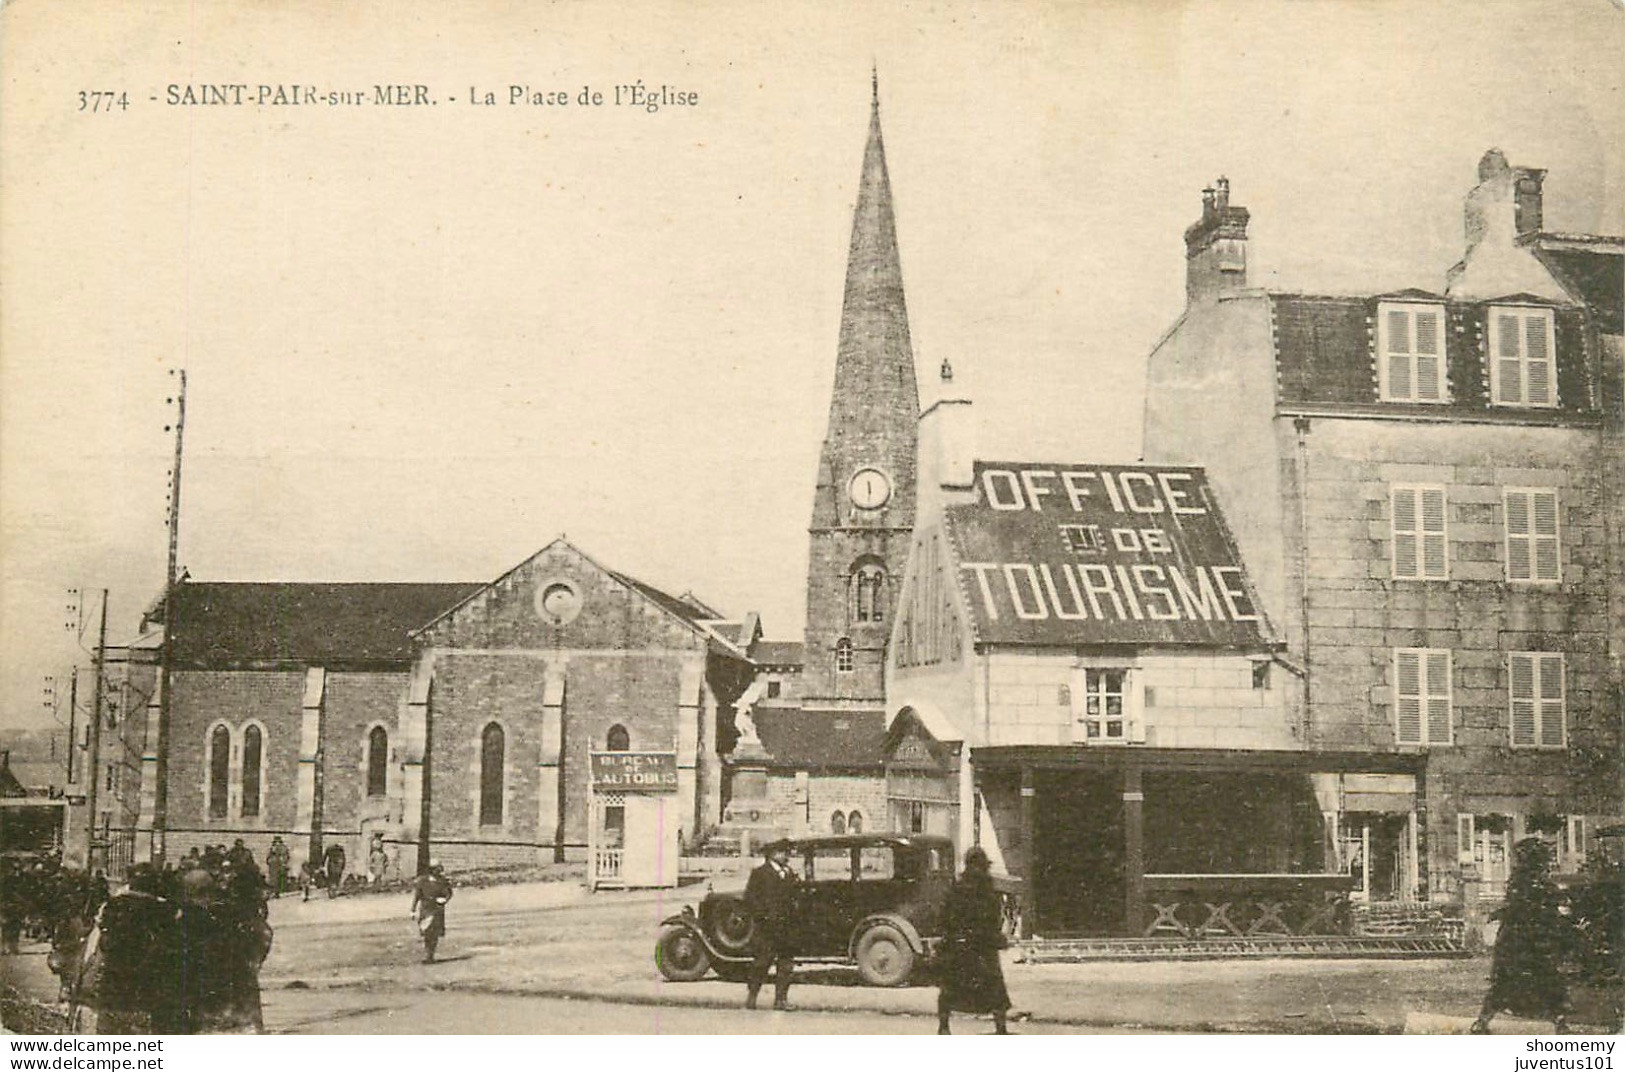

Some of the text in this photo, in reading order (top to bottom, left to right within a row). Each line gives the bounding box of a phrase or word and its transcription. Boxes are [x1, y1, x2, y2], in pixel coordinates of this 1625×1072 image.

[982, 469, 1207, 515] OFFICE
[1110, 528, 1172, 552] DE
[960, 562, 1261, 621] TOURISME
